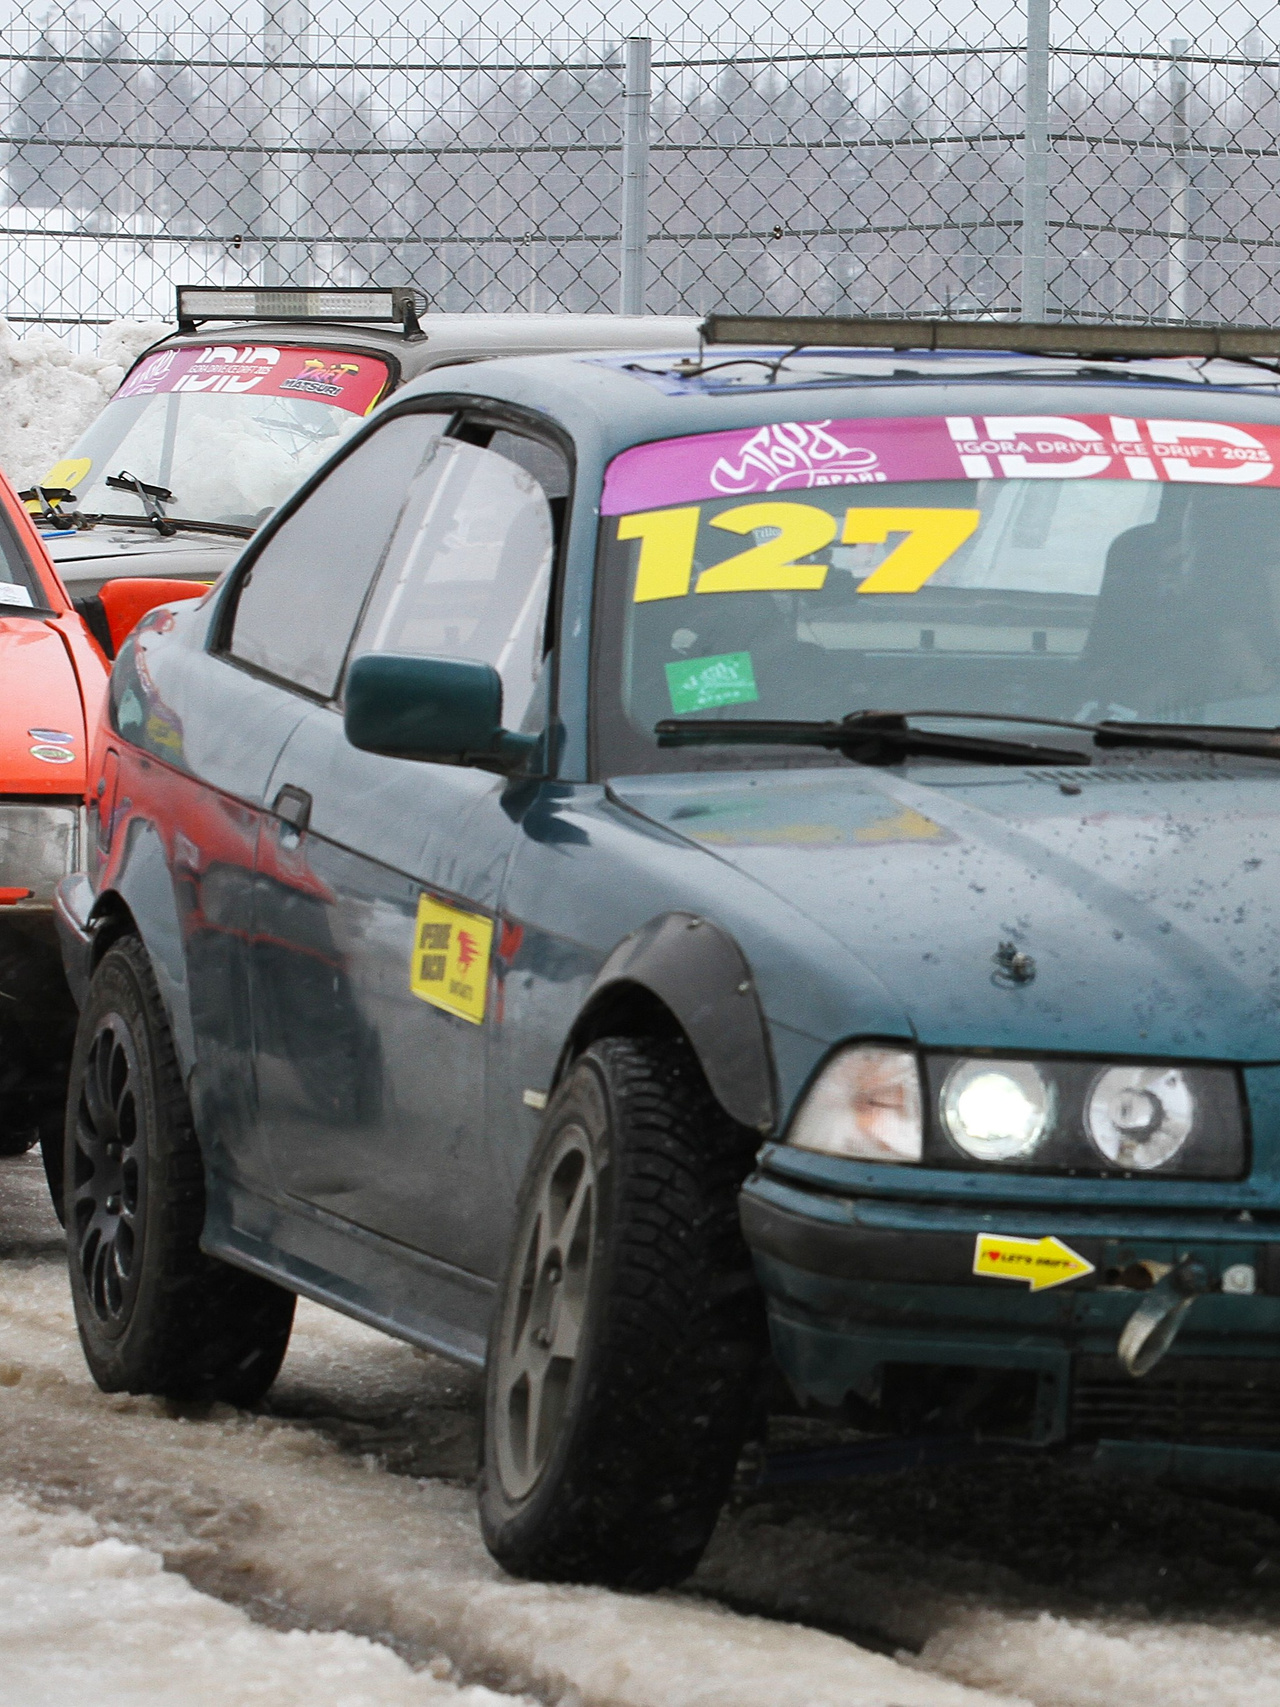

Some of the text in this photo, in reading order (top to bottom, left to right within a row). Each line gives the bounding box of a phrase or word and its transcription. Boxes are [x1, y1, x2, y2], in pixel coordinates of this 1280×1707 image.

[171, 347, 281, 392] IDID
[279, 378, 345, 397] MATSURI
[945, 416, 1274, 484] IDID
[955, 440, 1271, 461] IGORA DRIVE ICE DRIFT 2025
[616, 501, 981, 604] 127
